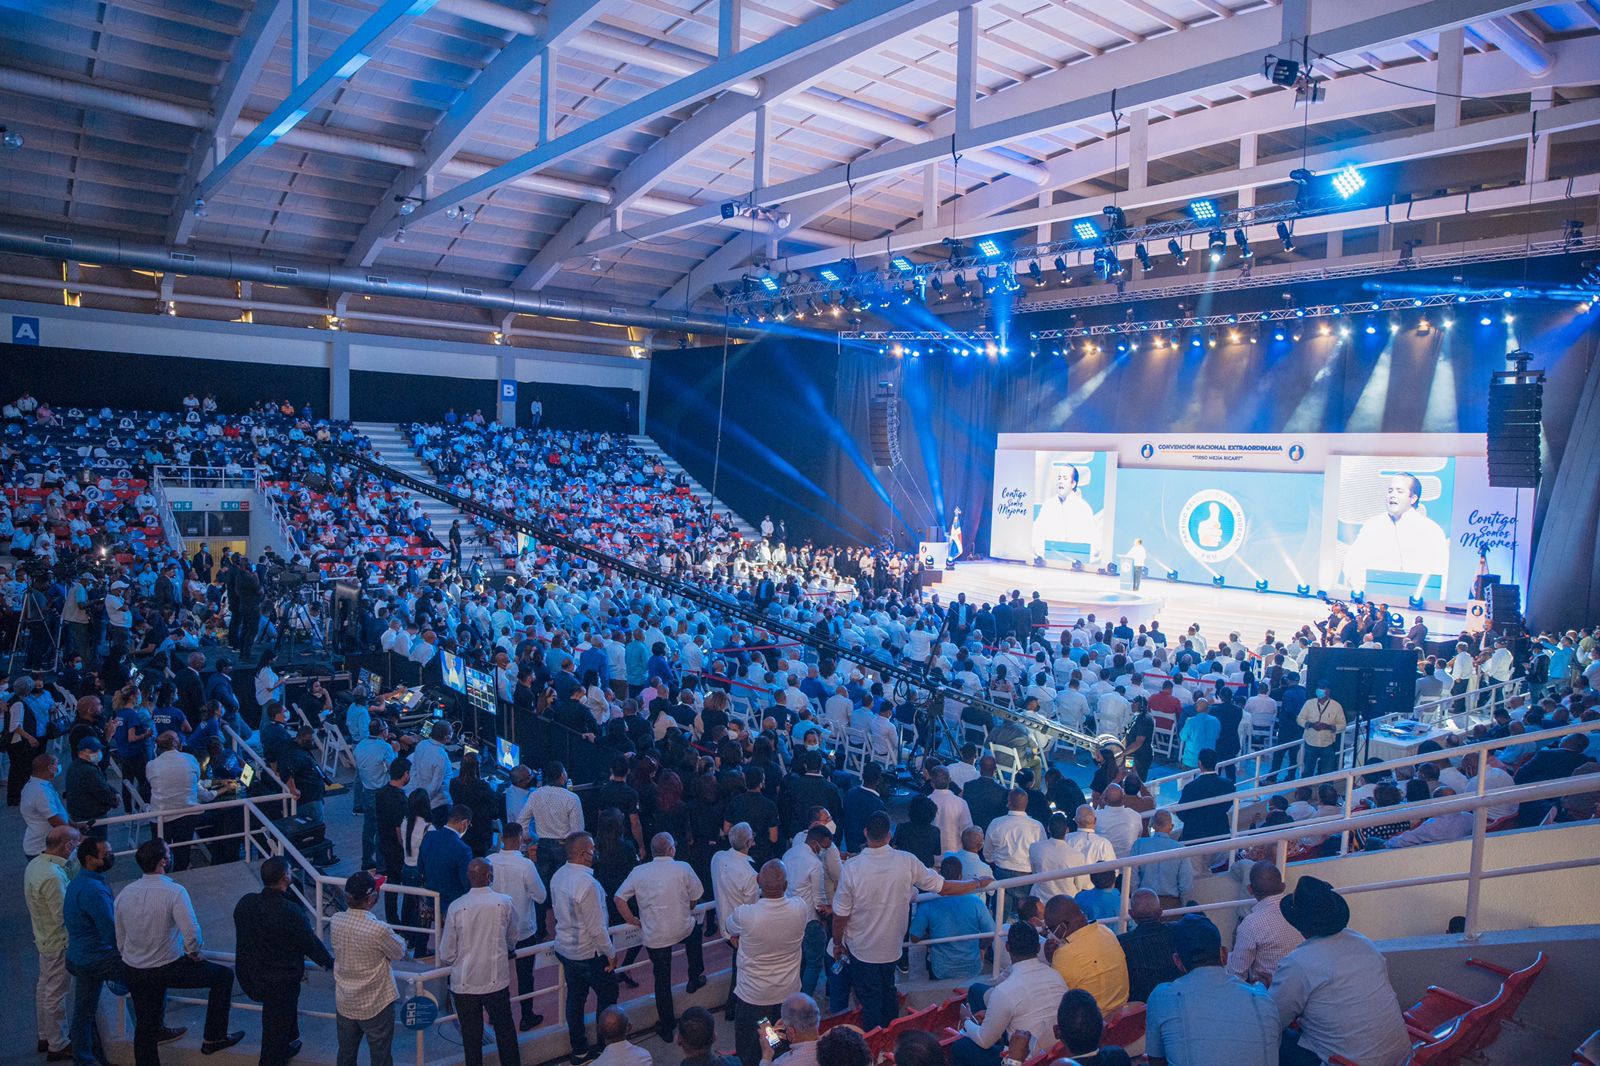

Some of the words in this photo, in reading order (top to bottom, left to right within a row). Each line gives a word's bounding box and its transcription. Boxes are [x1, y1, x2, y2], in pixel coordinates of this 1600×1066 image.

[15, 323, 37, 339] A
[503, 384, 515, 397] B
[1001, 487, 1027, 499] Contigo
[1468, 509, 1519, 531] Contigo
[1480, 526, 1511, 539] Somos
